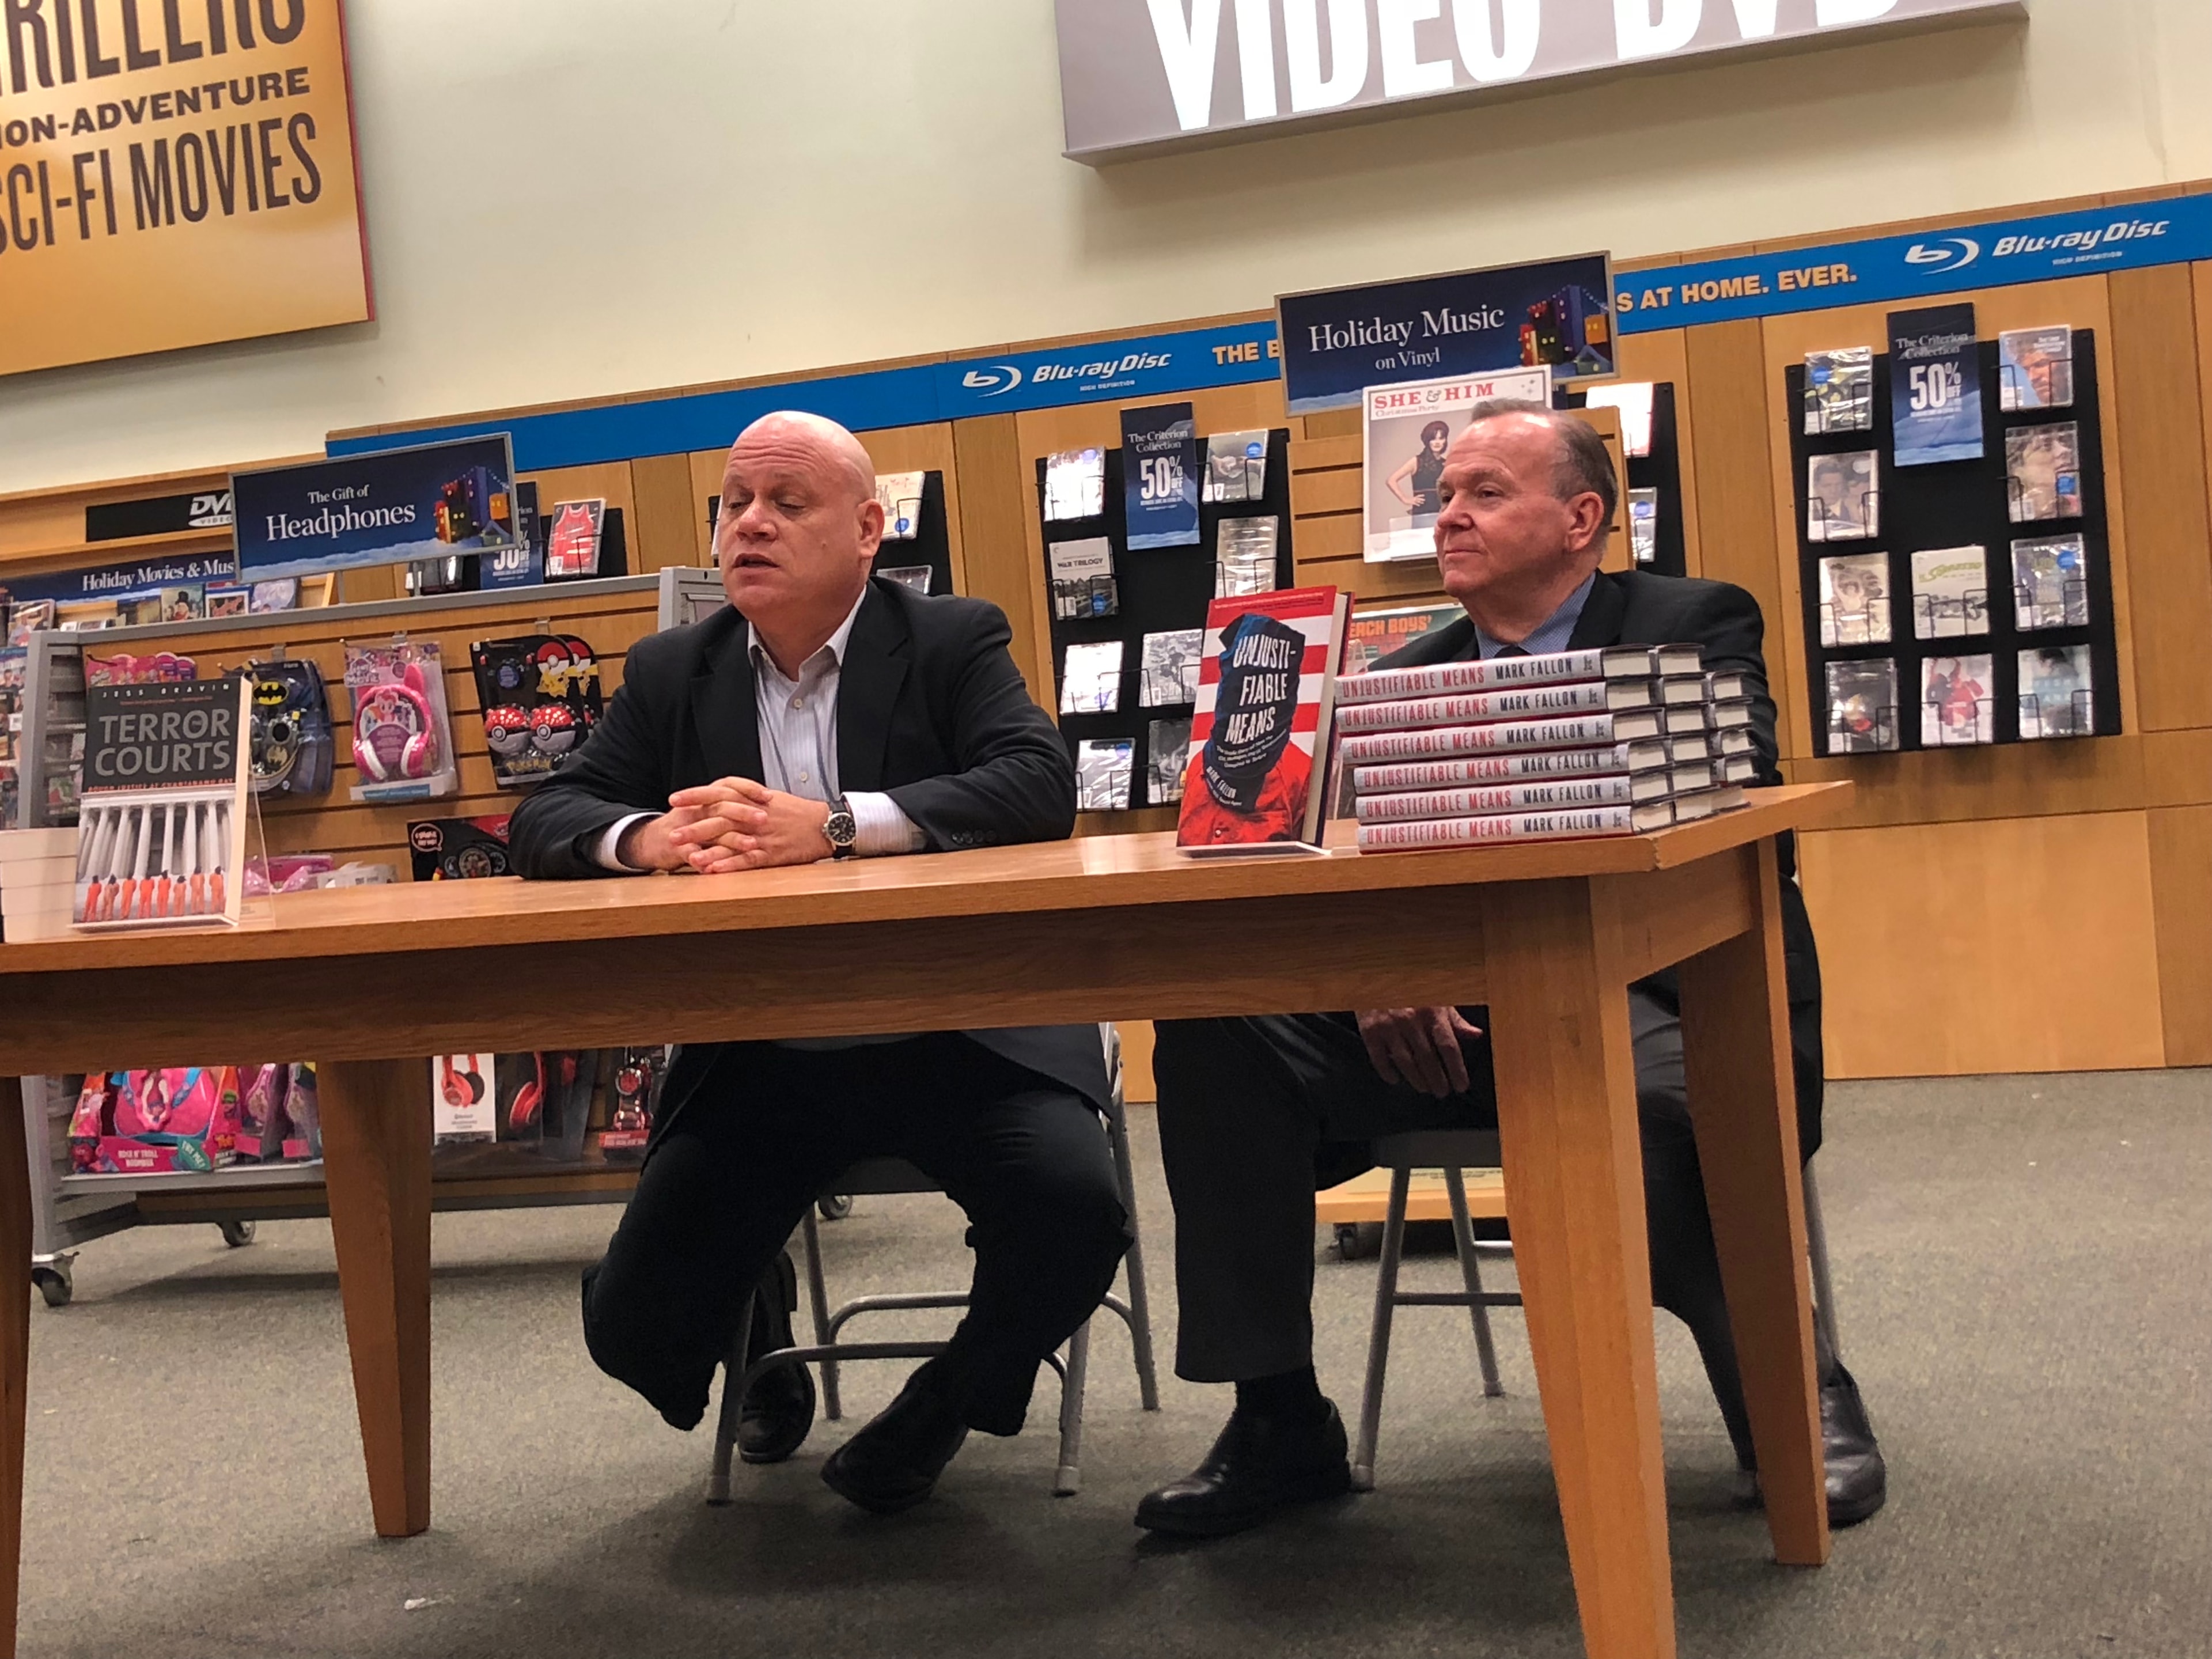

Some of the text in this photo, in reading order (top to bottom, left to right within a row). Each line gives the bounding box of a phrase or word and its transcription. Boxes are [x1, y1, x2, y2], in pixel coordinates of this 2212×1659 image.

[0, 66, 310, 150] ON-ADVENTURE
[0, 112, 321, 255] CI-FI MOVIES
[1992, 219, 2170, 257] Blu-ray Disc
[1639, 287, 1673, 310] AT
[1681, 275, 1770, 304] HOME.
[1777, 263, 1858, 291] EVER.
[1308, 304, 1505, 353] Holiday Music
[1896, 332, 1968, 349] The Criterion
[1032, 353, 1172, 383] Blu-ray Disc
[1212, 342, 1260, 366] THE
[1375, 347, 1441, 370] on Vinyl
[1904, 346, 1960, 359] Collection
[1374, 382, 1494, 410] SHE & HIM
[1910, 361, 1962, 410] 50%
[1127, 429, 1188, 443] The Criterion
[1135, 441, 1181, 453] Collection
[308, 484, 370, 505] The Gift of
[1140, 455, 1183, 500] 50%
[266, 503, 416, 541] Headphones
[82, 569, 135, 592] Holiday
[137, 560, 185, 585] Movies
[187, 562, 202, 578] &
[1073, 558, 1104, 567] TRILOGY
[1232, 634, 1296, 670] UNJUSTI-
[103, 688, 144, 698] JESS
[1239, 673, 1288, 707] FIABLE
[1342, 672, 1436, 697] UNJUSTIFIABLE
[1442, 666, 1485, 688] MEANS
[1496, 662, 1525, 680] MARK
[1530, 657, 1573, 676] FALLON
[99, 708, 230, 744] TERROR
[1224, 706, 1276, 745] MEANS
[1344, 702, 1439, 726] UNJUSTIFIABLE
[1445, 698, 1488, 717] MEANS
[1499, 694, 1529, 712] MARK
[1535, 690, 1578, 709] FALLON
[94, 740, 230, 777] COURTS
[1351, 722, 1585, 759] UNJUSTIFIABLE MEANS MARK FALLON
[1363, 751, 1600, 788] UNJUSTIFIABLE MEANS MARK FALLON
[1365, 783, 1602, 818] UNJUSTIFIABLE MEANS MARK FALLON
[1366, 813, 1602, 845] UNJUSTIFIABLE MEANS MARK FALLON
